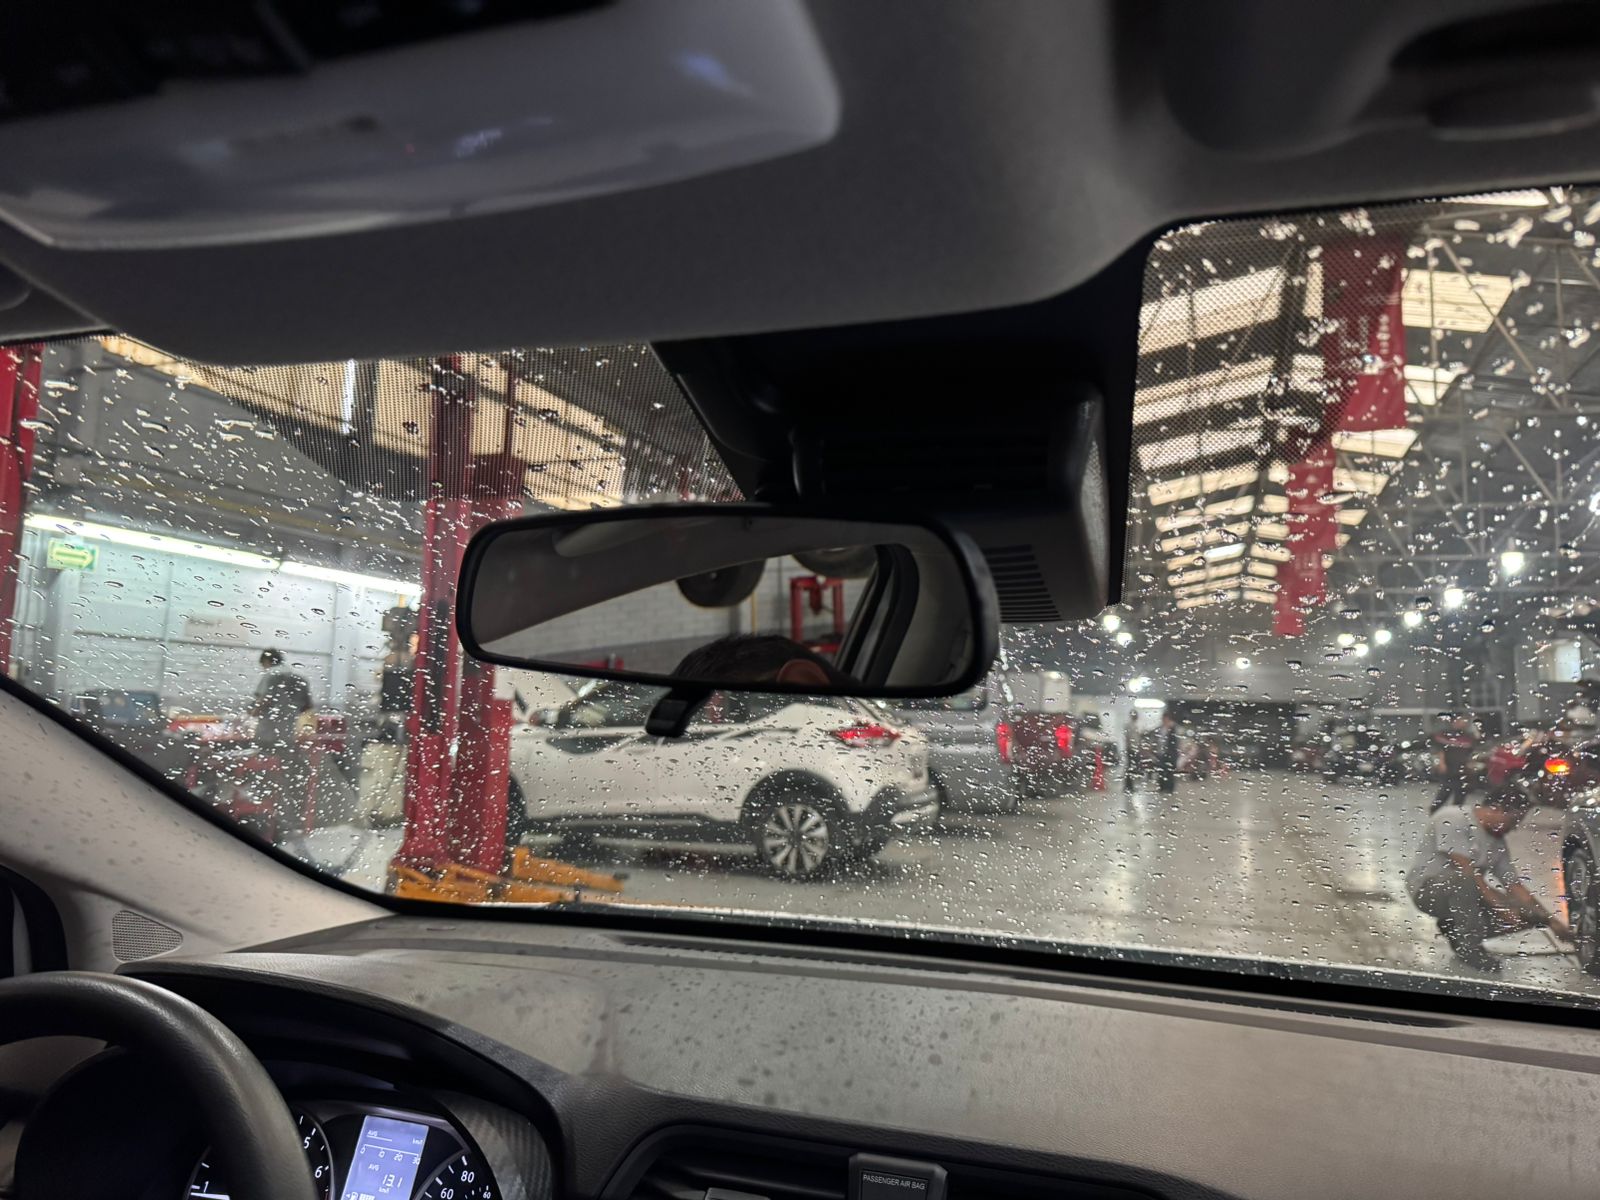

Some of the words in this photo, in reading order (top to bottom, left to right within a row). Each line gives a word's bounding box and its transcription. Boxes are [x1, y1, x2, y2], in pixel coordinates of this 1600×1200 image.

[303, 1136, 311, 1149] 5
[314, 1165, 323, 1178] 6
[460, 1170, 475, 1183] 80
[203, 1180, 209, 1193] 1
[863, 1174, 900, 1185] PASSENGER
[911, 1182, 925, 1190] BAG
[440, 1187, 454, 1200] 60
[482, 1191, 492, 1200] 60
